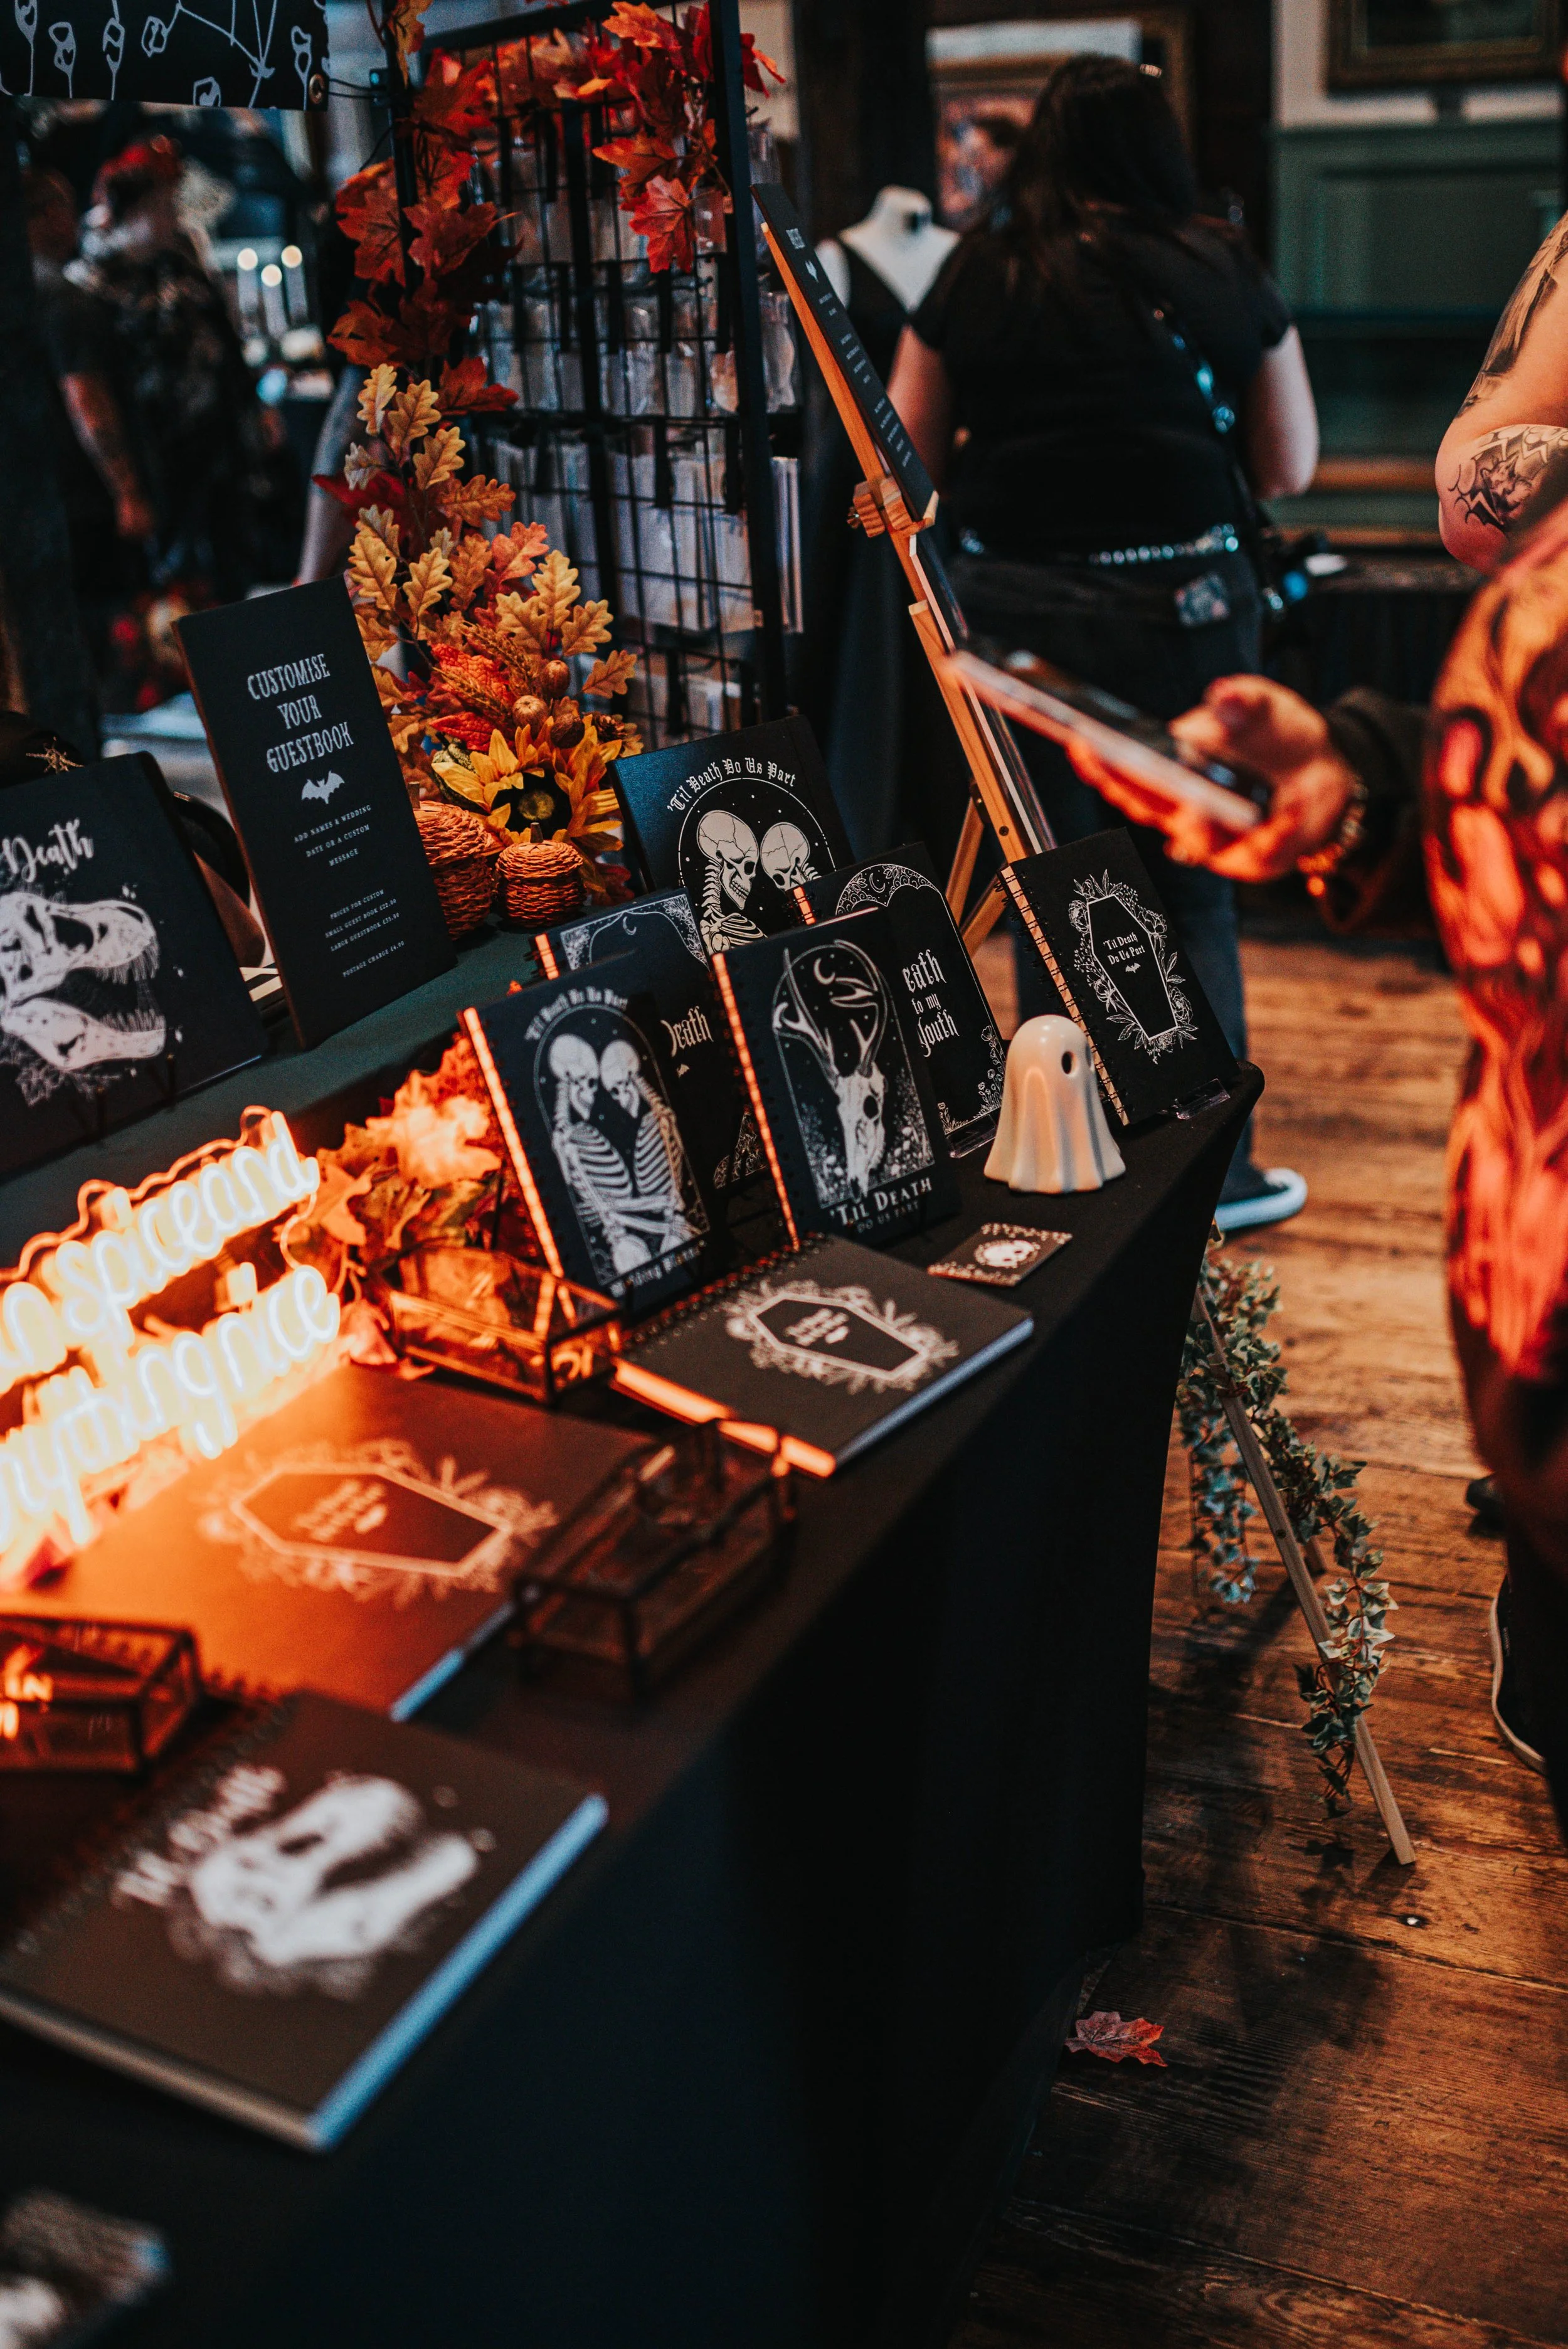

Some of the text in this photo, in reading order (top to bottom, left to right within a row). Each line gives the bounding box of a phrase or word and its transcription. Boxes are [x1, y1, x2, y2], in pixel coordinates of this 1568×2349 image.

[247, 653, 331, 700] CUSTOMISE
[277, 694, 322, 729] YOUR
[266, 721, 354, 773] GUESTBOOK
[686, 761, 723, 793] Death
[722, 758, 741, 775] Do
[744, 757, 763, 774] Us
[767, 760, 797, 787] Part
[294, 832, 309, 843] ADD
[310, 821, 333, 835] NAMES
[341, 804, 371, 822] WEDDING
[305, 845, 324, 857] DATE
[326, 839, 336, 848] OR
[343, 824, 370, 840] CUSTOM
[329, 848, 359, 866] MESSAGE
[330, 889, 384, 920] PRICES FOR CUSTOM
[324, 926, 344, 938] SMALL
[344, 915, 362, 928] GUEST
[363, 908, 378, 919] BOOK
[330, 939, 349, 952] LARGE
[349, 921, 382, 941] GUESTBOOK
[1103, 931, 1138, 950] 'Til Death
[1107, 945, 1145, 965] Do Us Part
[342, 961, 367, 978] POSTAGE
[368, 949, 389, 963] CHARGE
[901, 949, 946, 993] eath
[911, 993, 941, 1015] to my
[216, 1262, 340, 1394] nice
